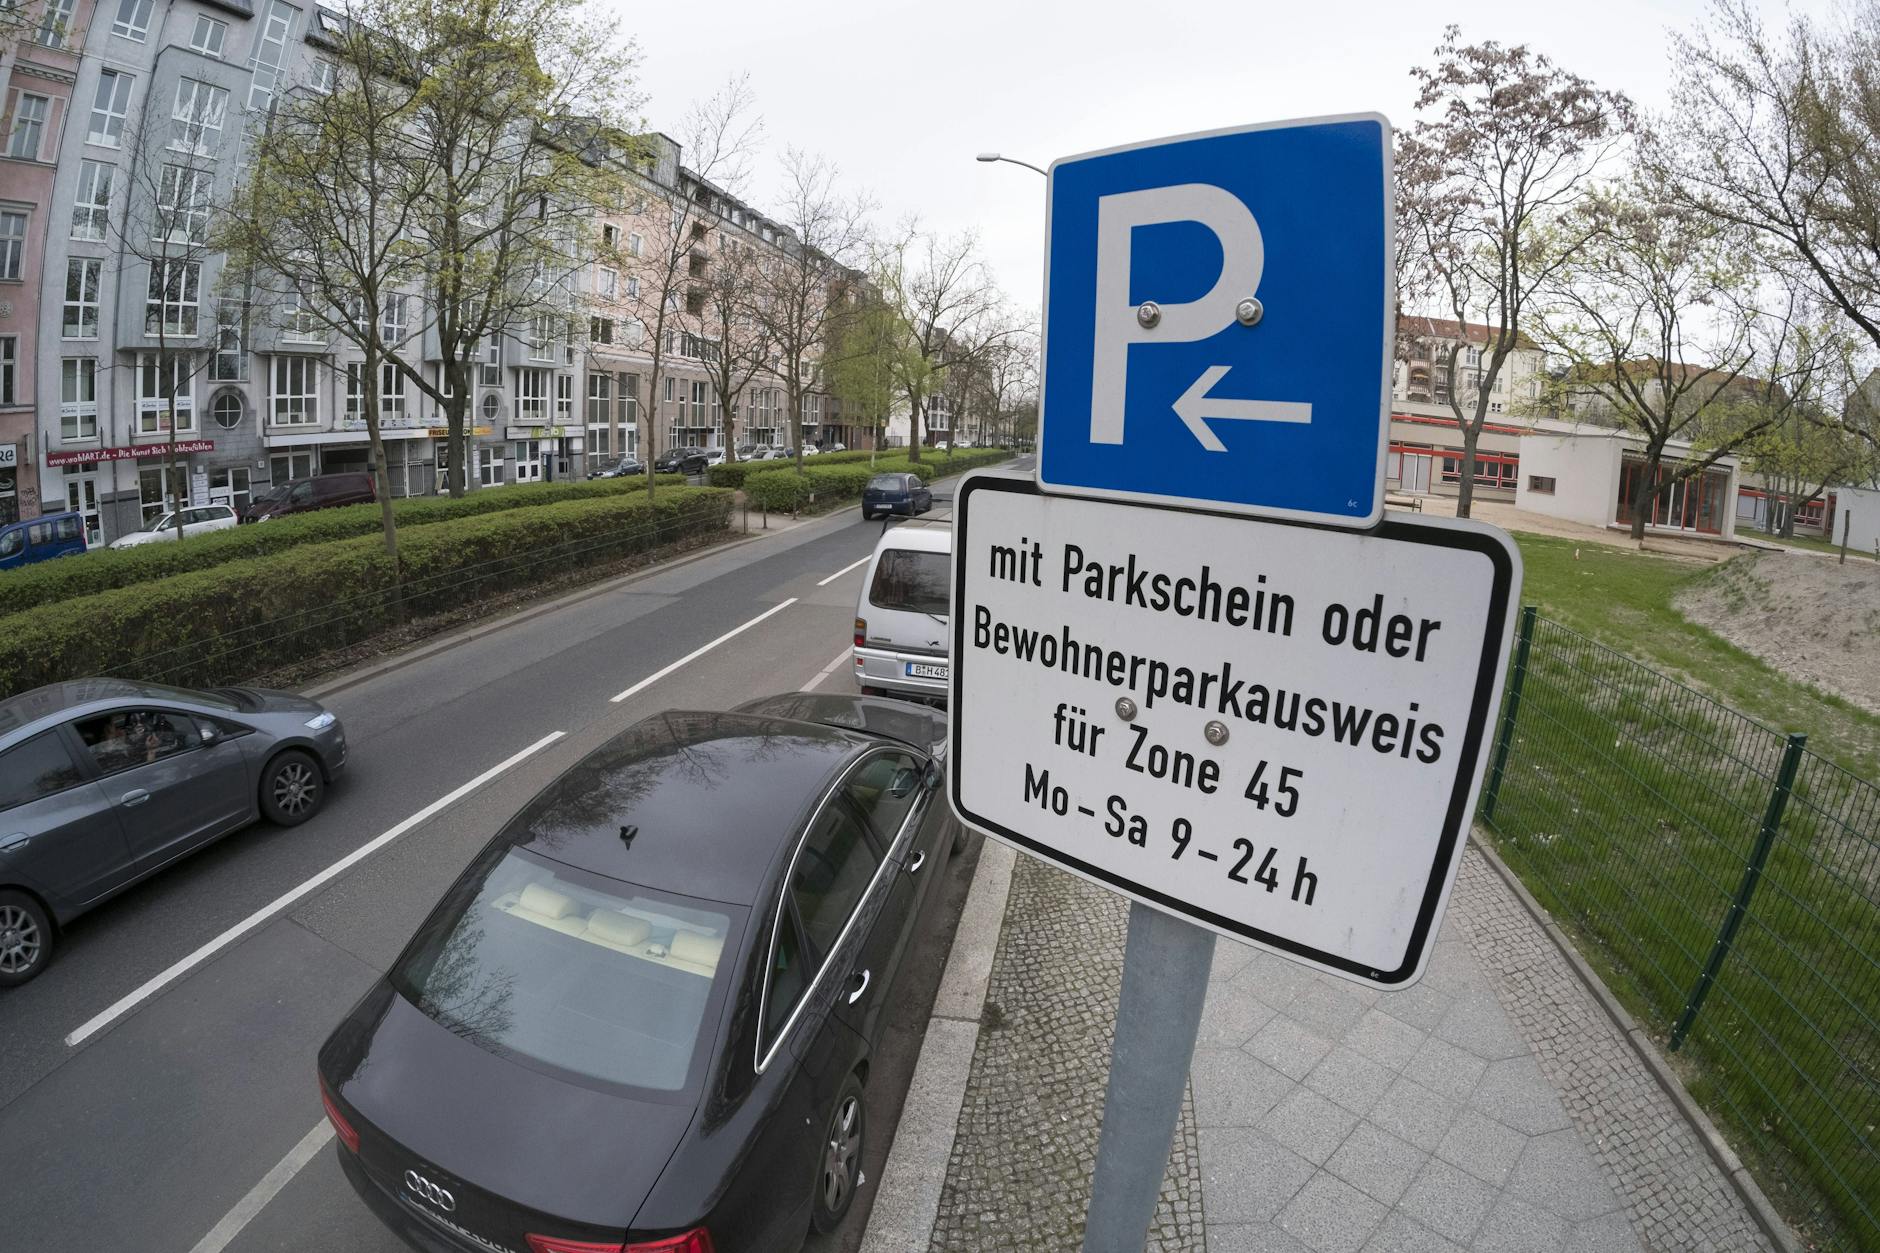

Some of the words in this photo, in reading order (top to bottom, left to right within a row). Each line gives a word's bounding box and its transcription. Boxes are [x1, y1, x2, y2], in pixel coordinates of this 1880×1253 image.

[1090, 183, 1264, 445] P
[49, 451, 111, 465] www.wohlART.de
[118, 449, 130, 458] Die
[131, 448, 150, 456] Kunst
[151, 445, 167, 454] Sich
[167, 442, 213, 453] ohlzufühlen
[991, 537, 1043, 587] mit
[1063, 543, 1295, 637] Parkschein
[1323, 594, 1442, 663] oder
[974, 604, 1445, 764] Bewohnerparkausweis
[1053, 703, 1106, 758] für
[1125, 723, 1220, 795] Zone
[1244, 759, 1304, 818] 45
